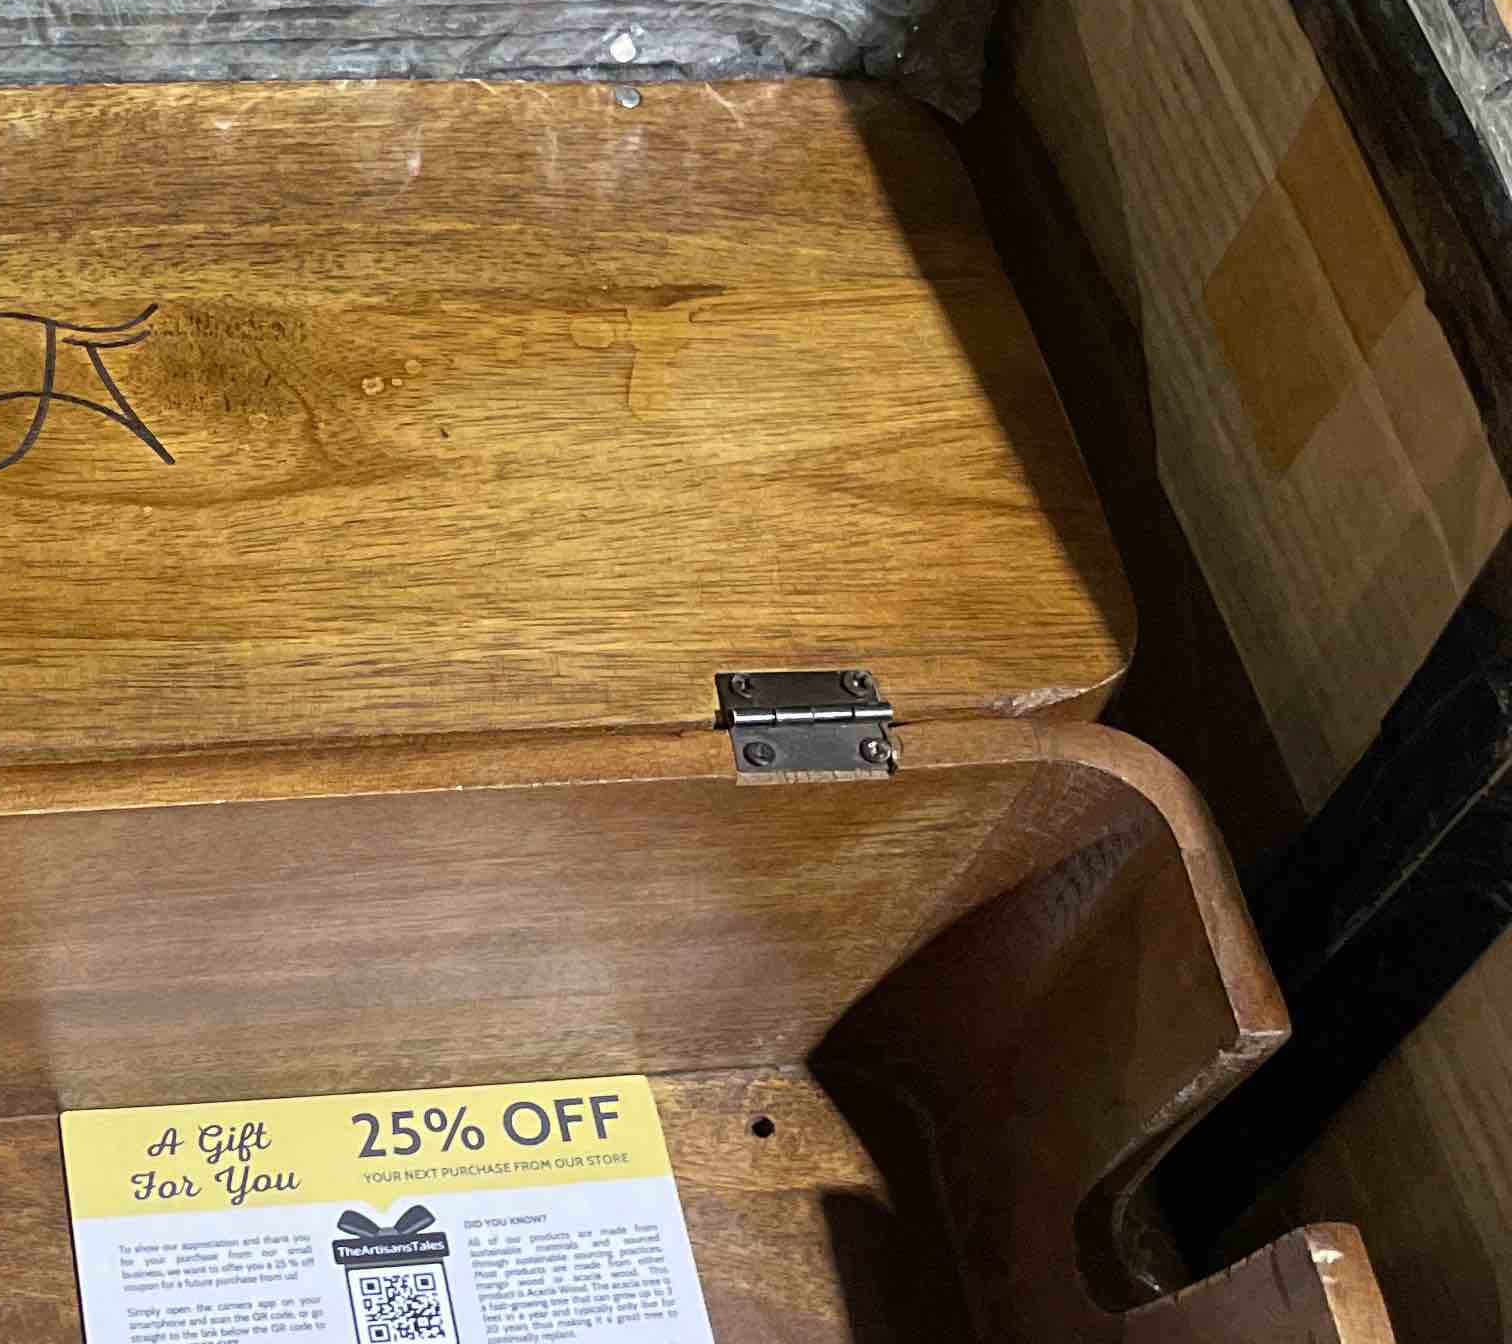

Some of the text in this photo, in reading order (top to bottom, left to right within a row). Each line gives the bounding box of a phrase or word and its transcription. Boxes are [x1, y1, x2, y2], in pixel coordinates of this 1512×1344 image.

[148, 1122, 272, 1164] A Gift
[352, 1095, 619, 1158] 25% OFF
[131, 1165, 301, 1206] For You
[363, 1153, 629, 1184] YOUR NEXT PURCHASE FROM OUR STORE
[464, 1214, 546, 1229] DID YOU KNOW?
[338, 1240, 445, 1258] TheArtisansTales
